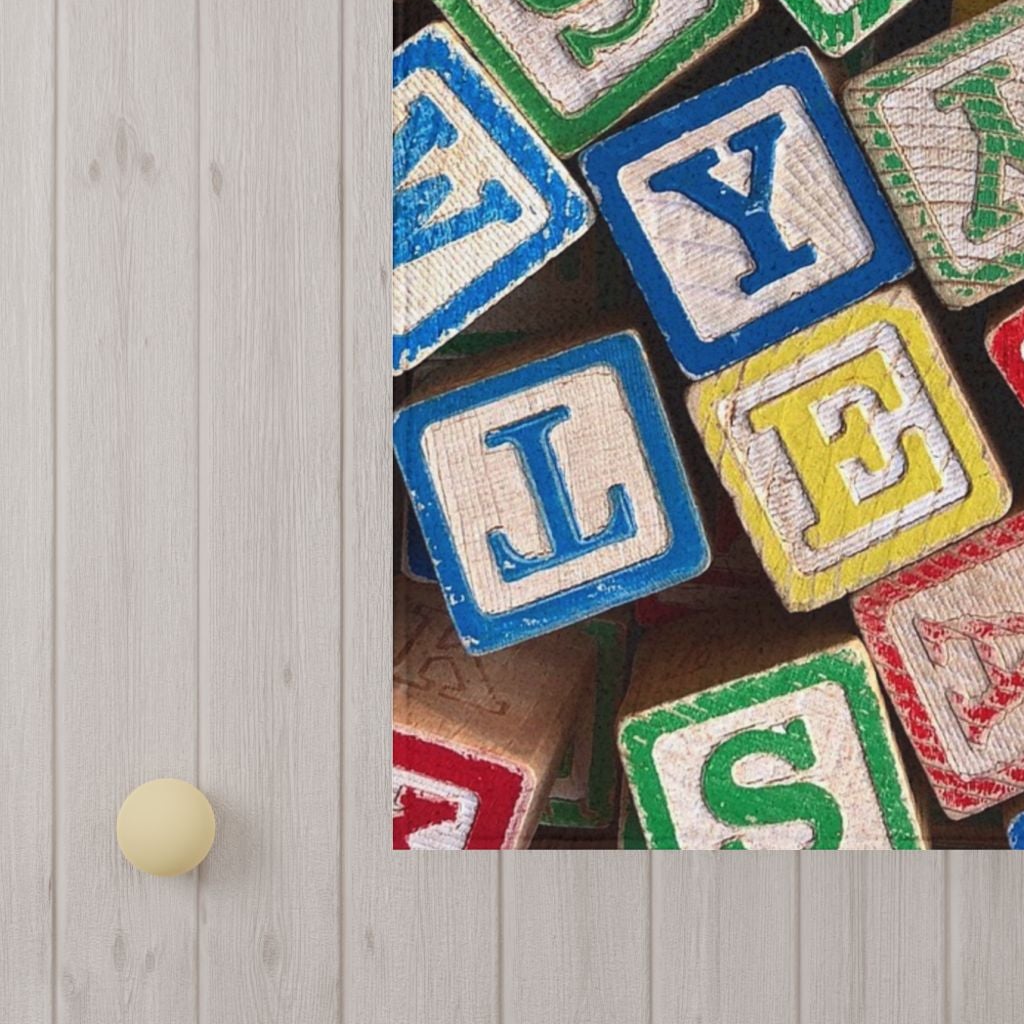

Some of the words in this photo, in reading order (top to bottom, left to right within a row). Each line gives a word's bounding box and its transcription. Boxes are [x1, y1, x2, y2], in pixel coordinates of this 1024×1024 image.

[647, 113, 819, 296] Y
[483, 404, 639, 583] T
[749, 349, 945, 552] E
[700, 716, 844, 849] S
